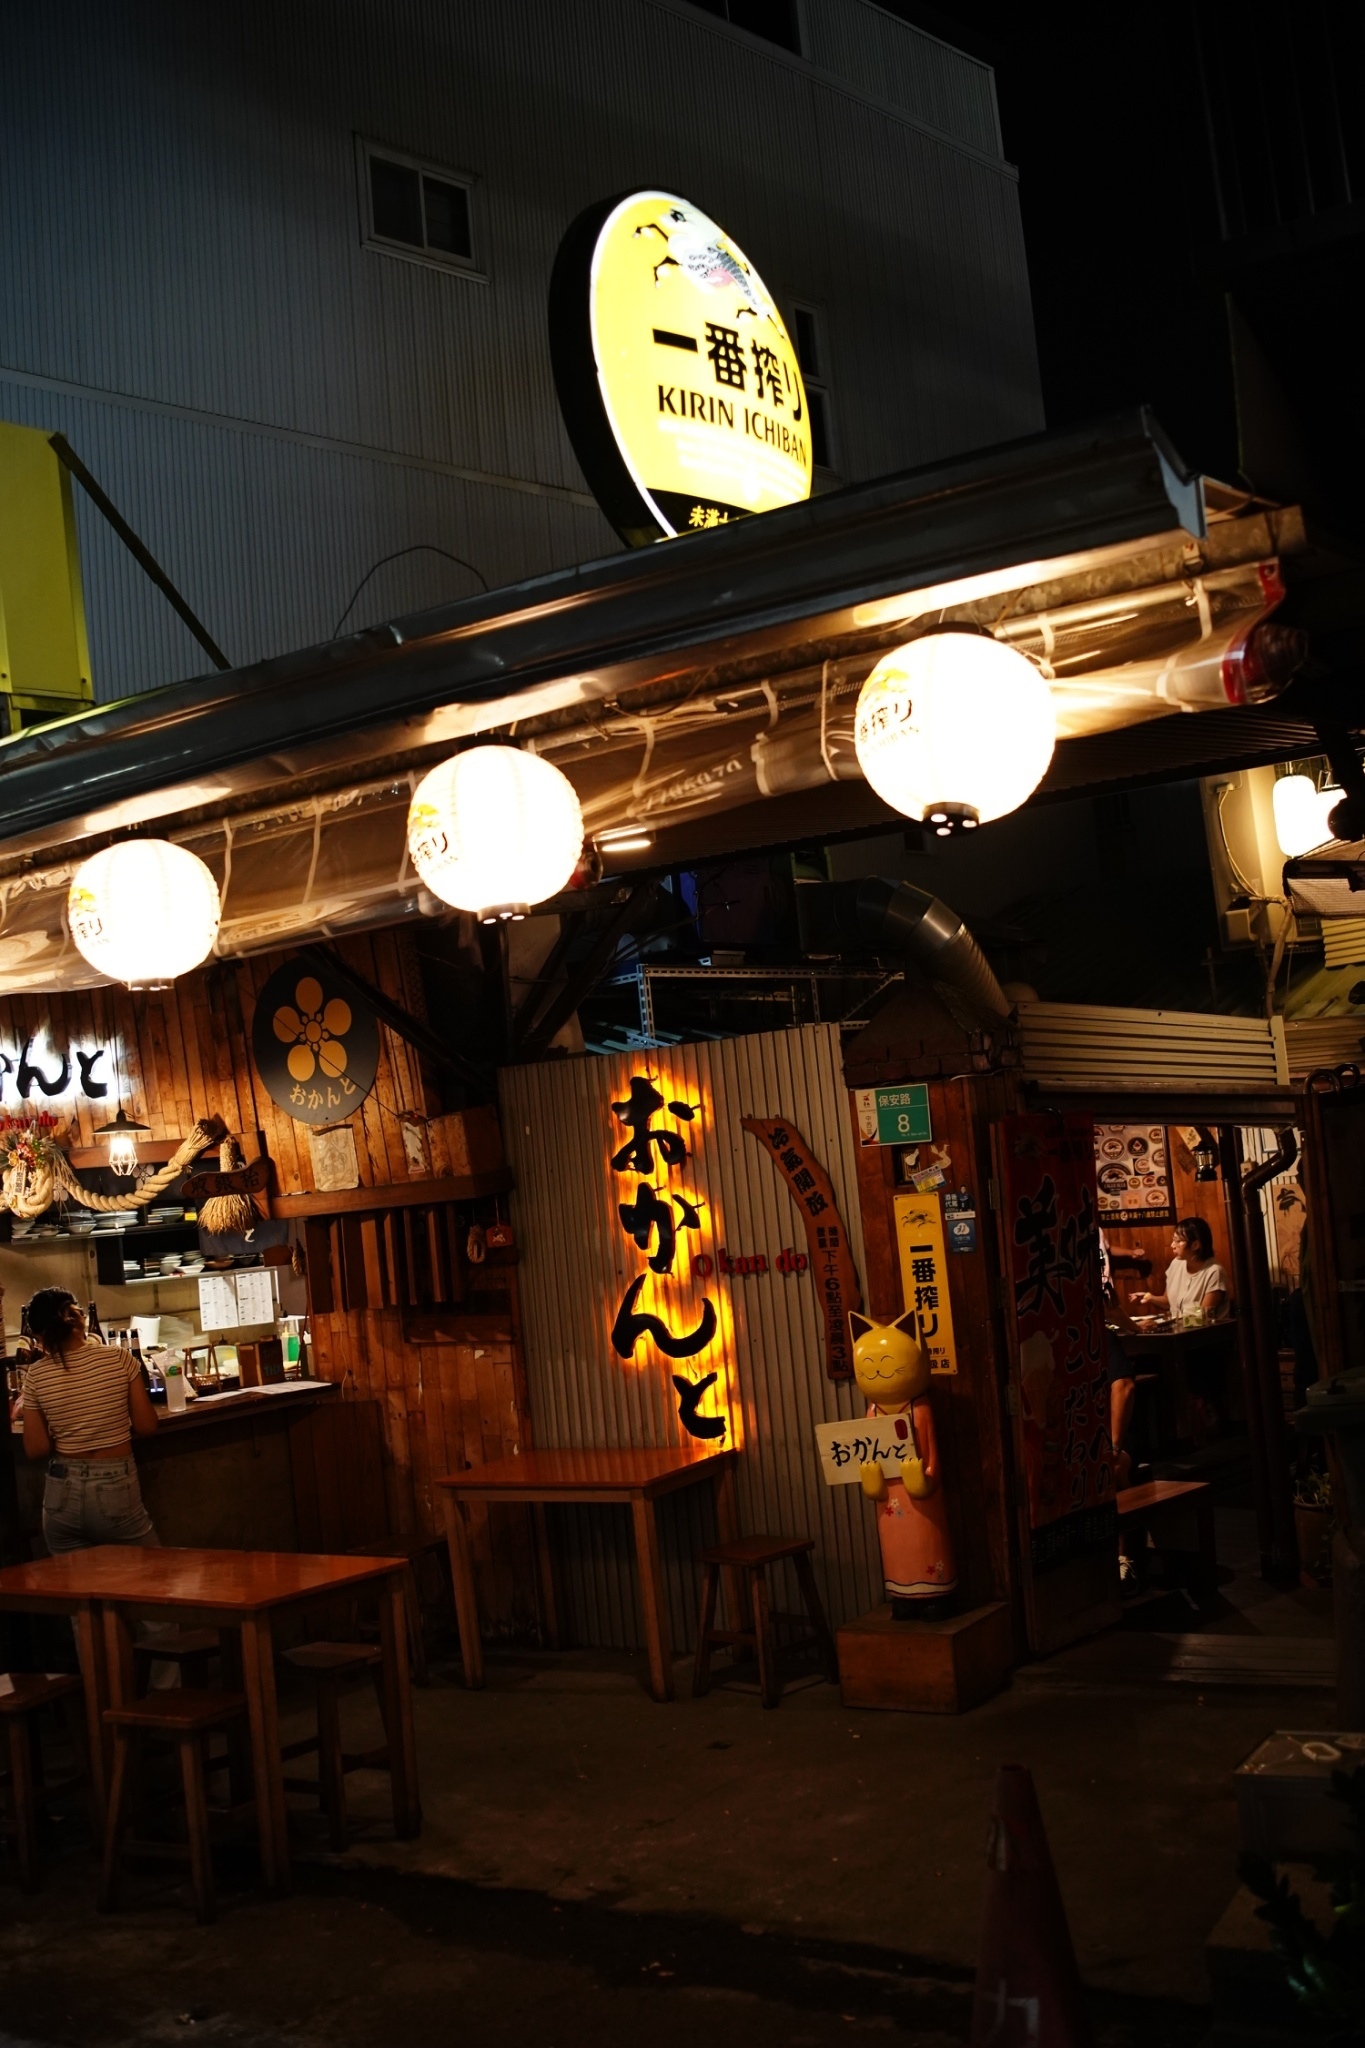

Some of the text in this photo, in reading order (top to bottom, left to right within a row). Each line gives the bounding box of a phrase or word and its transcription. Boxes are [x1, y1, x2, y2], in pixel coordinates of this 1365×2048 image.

[652, 322, 802, 422] 一番搾り
[657, 384, 735, 429] KIRIN
[744, 407, 808, 467] ICHIBAN
[290, 1078, 356, 1110] おかんと
[878, 1093, 911, 1107] 保安路
[897, 1113, 911, 1133] 8
[768, 1127, 829, 1217] 冷氣開放
[610, 1074, 727, 1441] おかんと
[909, 1244, 939, 1338] 一番搾り
[830, 1436, 908, 1467] おかんと
